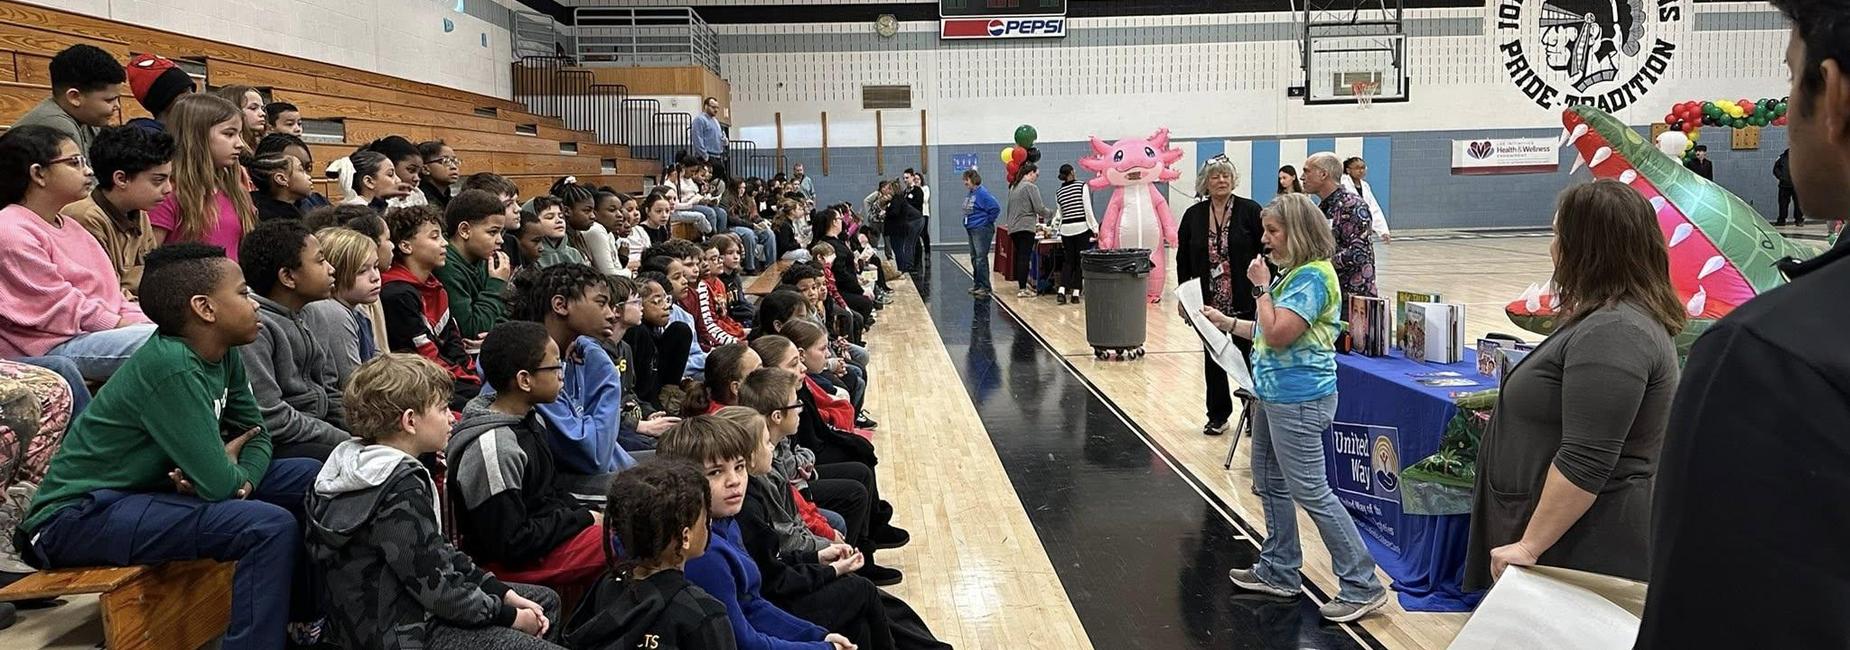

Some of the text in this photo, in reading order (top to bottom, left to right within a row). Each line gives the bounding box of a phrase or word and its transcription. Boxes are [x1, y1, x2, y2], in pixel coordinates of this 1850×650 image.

[1005, 20, 1063, 34] PEPSI
[1500, 39, 1558, 110] PRIDE
[1496, 146, 1517, 154] Health
[1523, 145, 1551, 153] Wellness
[1334, 431, 1370, 457] United
[1351, 458, 1371, 490] Way
[637, 634, 660, 649] TS
